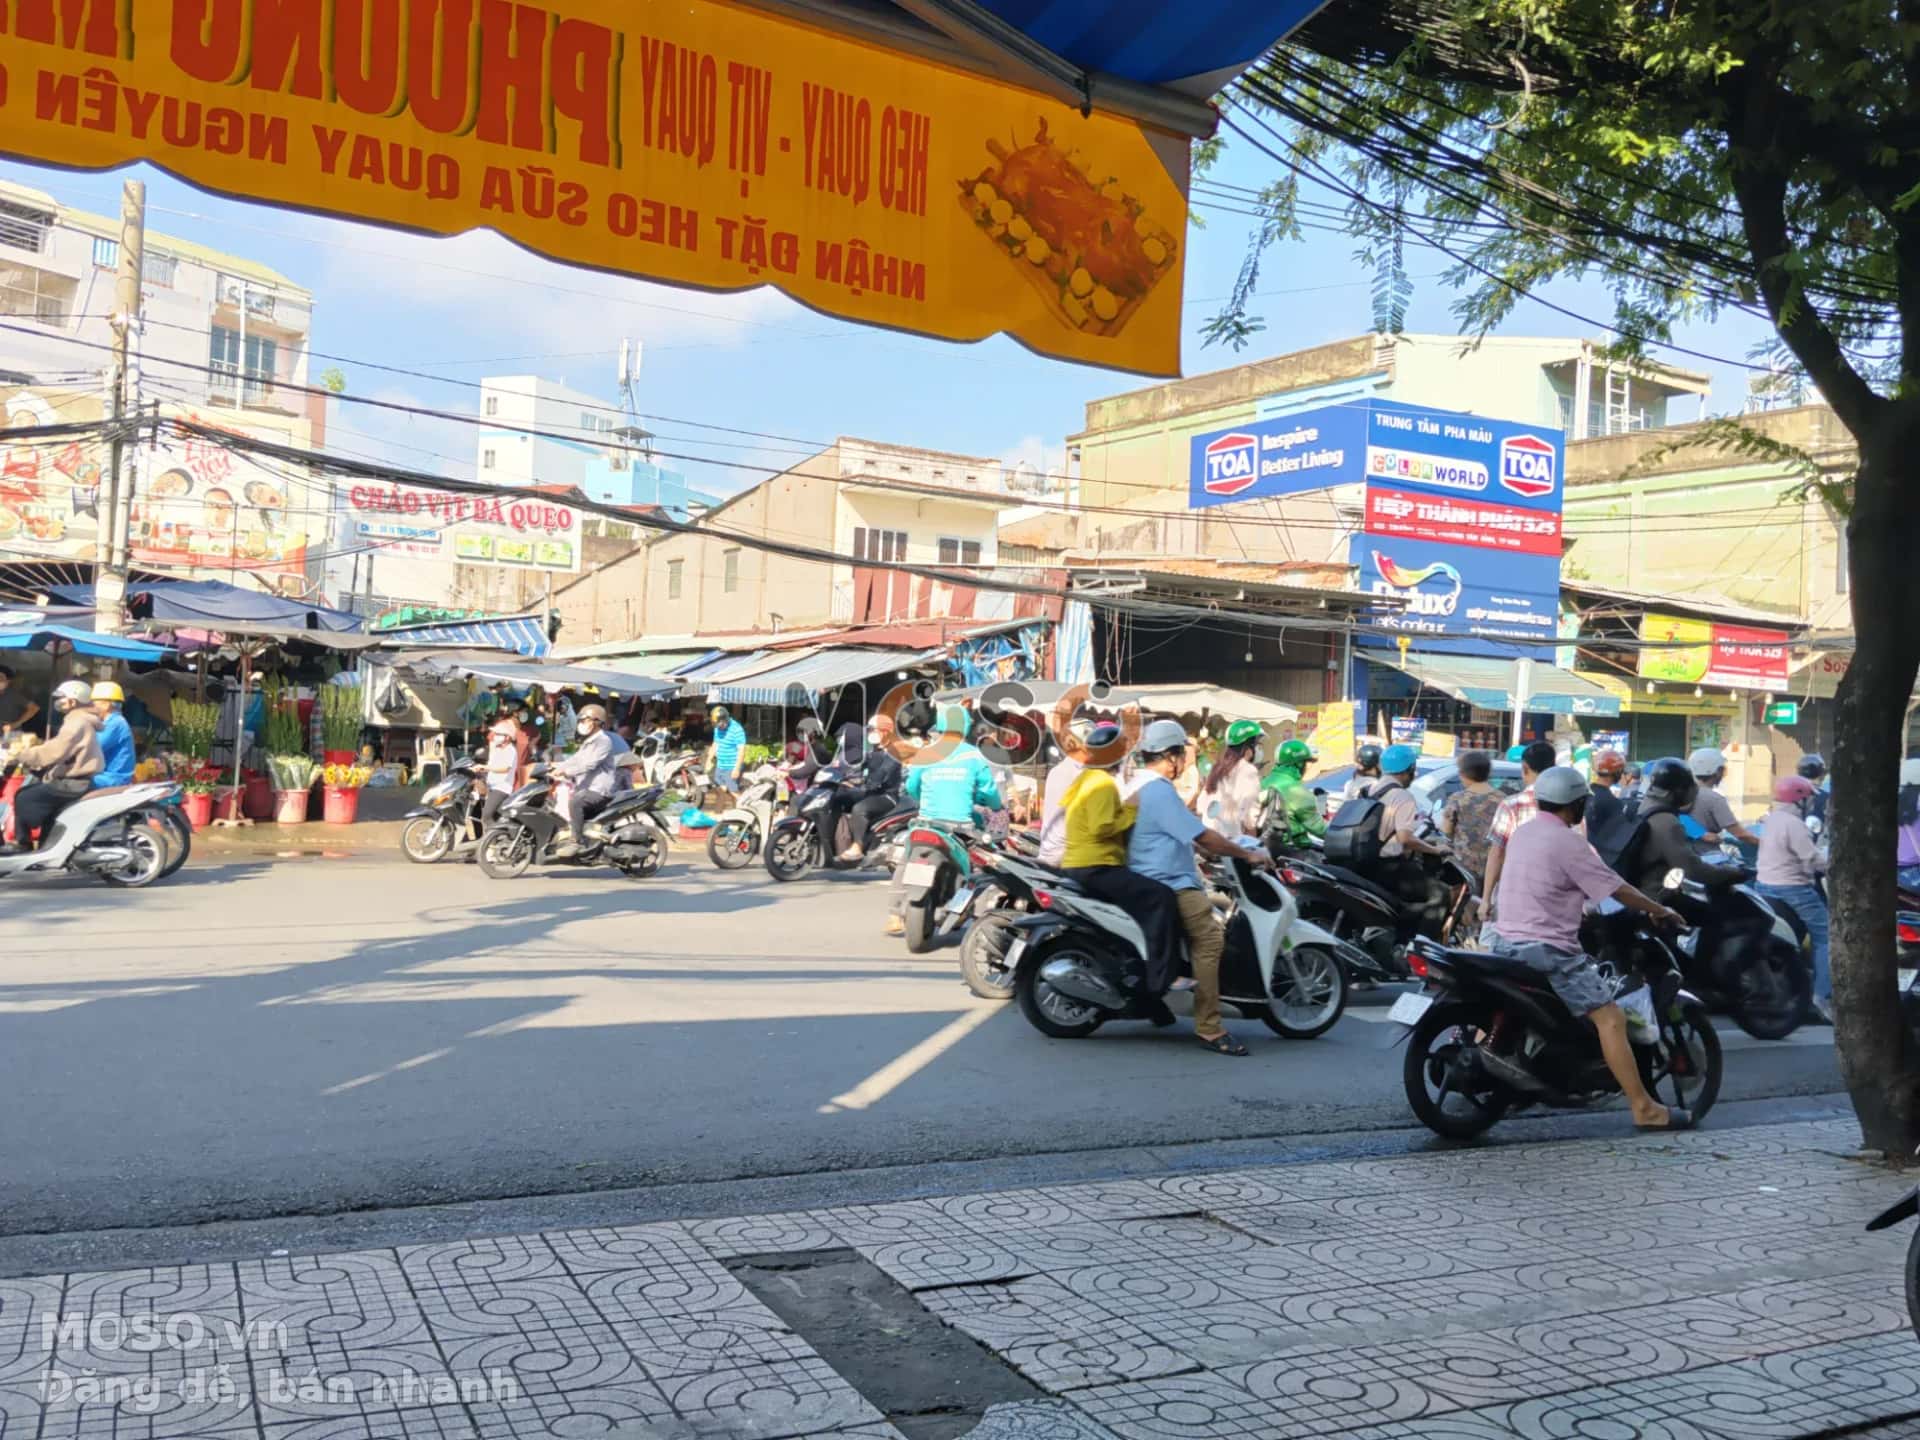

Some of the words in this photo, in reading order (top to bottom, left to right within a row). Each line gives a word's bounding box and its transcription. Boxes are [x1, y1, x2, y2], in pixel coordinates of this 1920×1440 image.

[1261, 426, 1319, 451] Inspire
[1375, 413, 1413, 432] TRUNG
[1443, 425, 1466, 441] PHA
[1208, 450, 1252, 480] TOA
[1505, 451, 1551, 482] TOA
